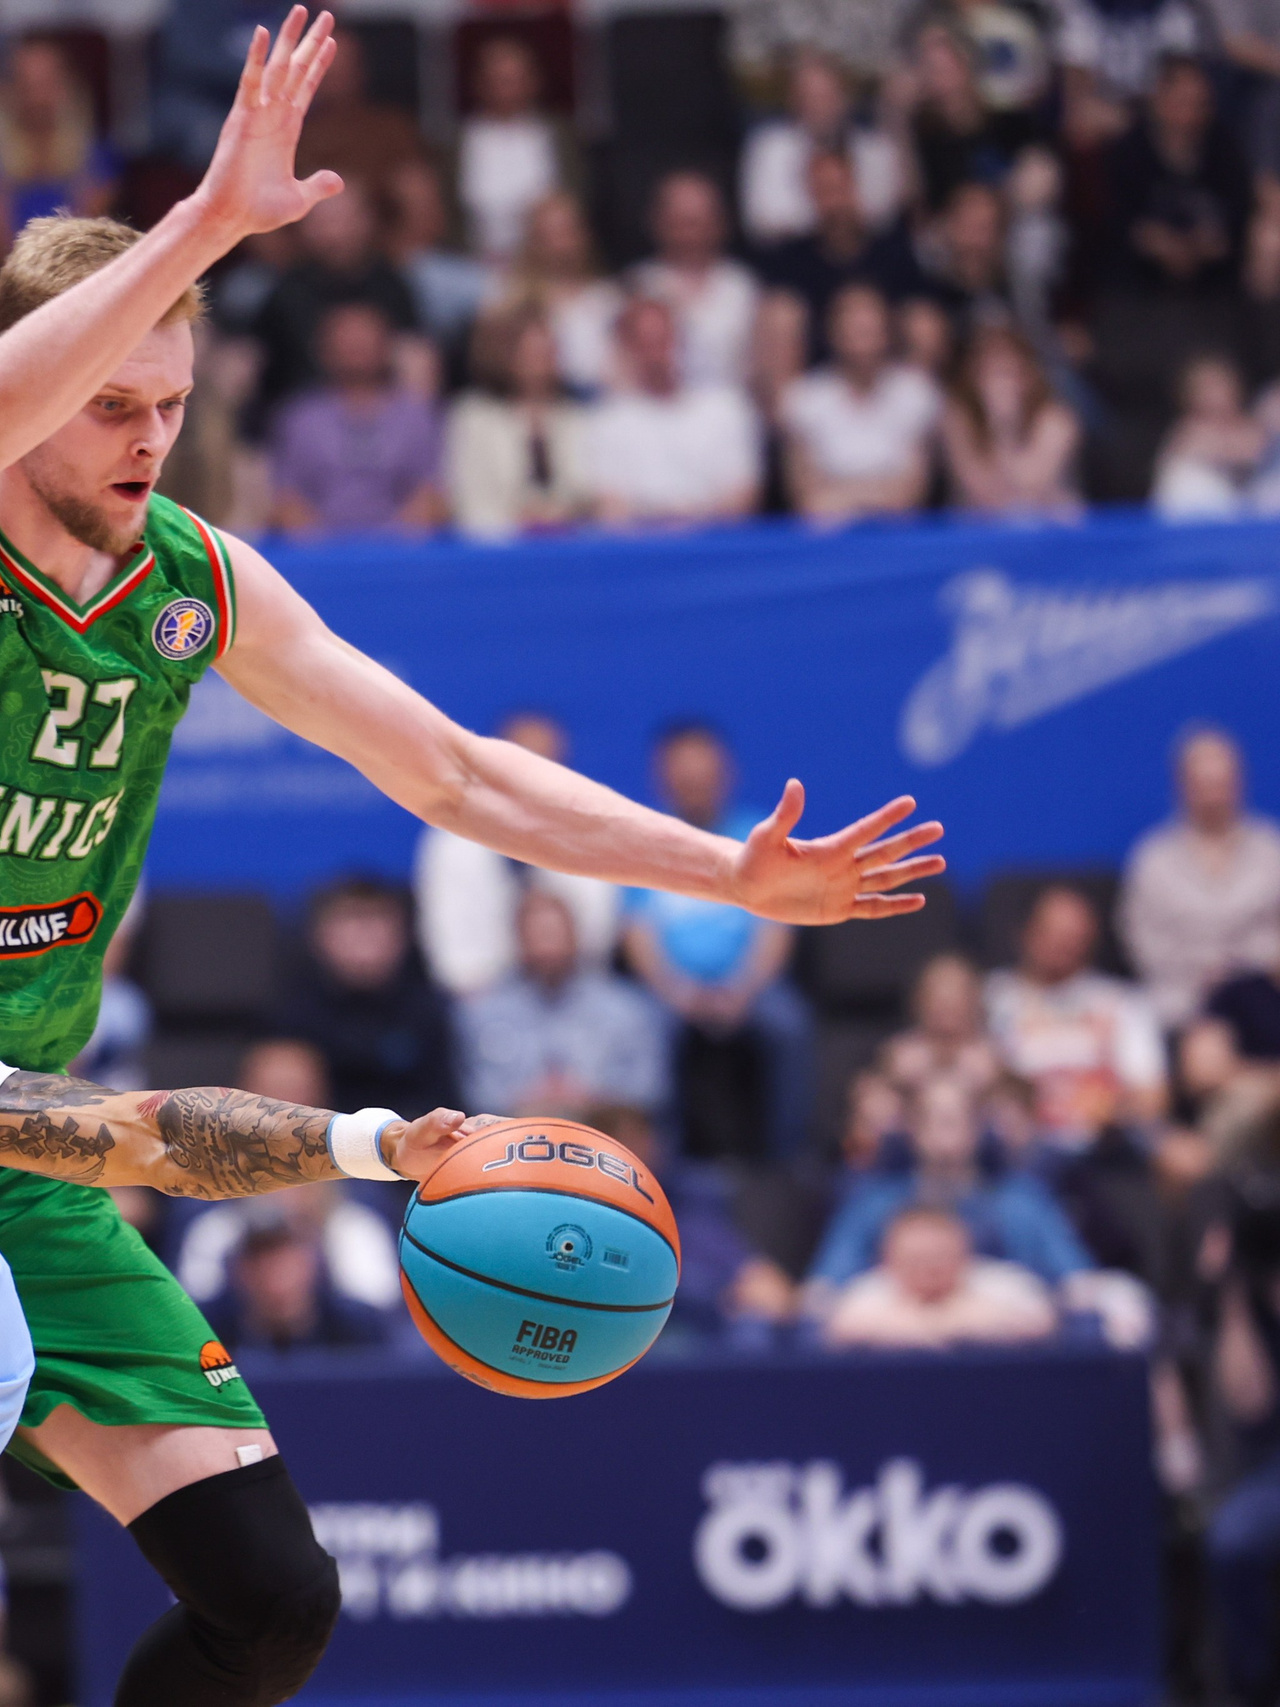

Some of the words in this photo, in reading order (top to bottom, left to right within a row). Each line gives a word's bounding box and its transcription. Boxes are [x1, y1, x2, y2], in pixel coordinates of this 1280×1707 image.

[30, 668, 138, 770] 27
[482, 1135, 655, 1205] JÖGEL
[511, 1344, 570, 1364] APPROVED
[516, 1319, 578, 1353] FIBA
